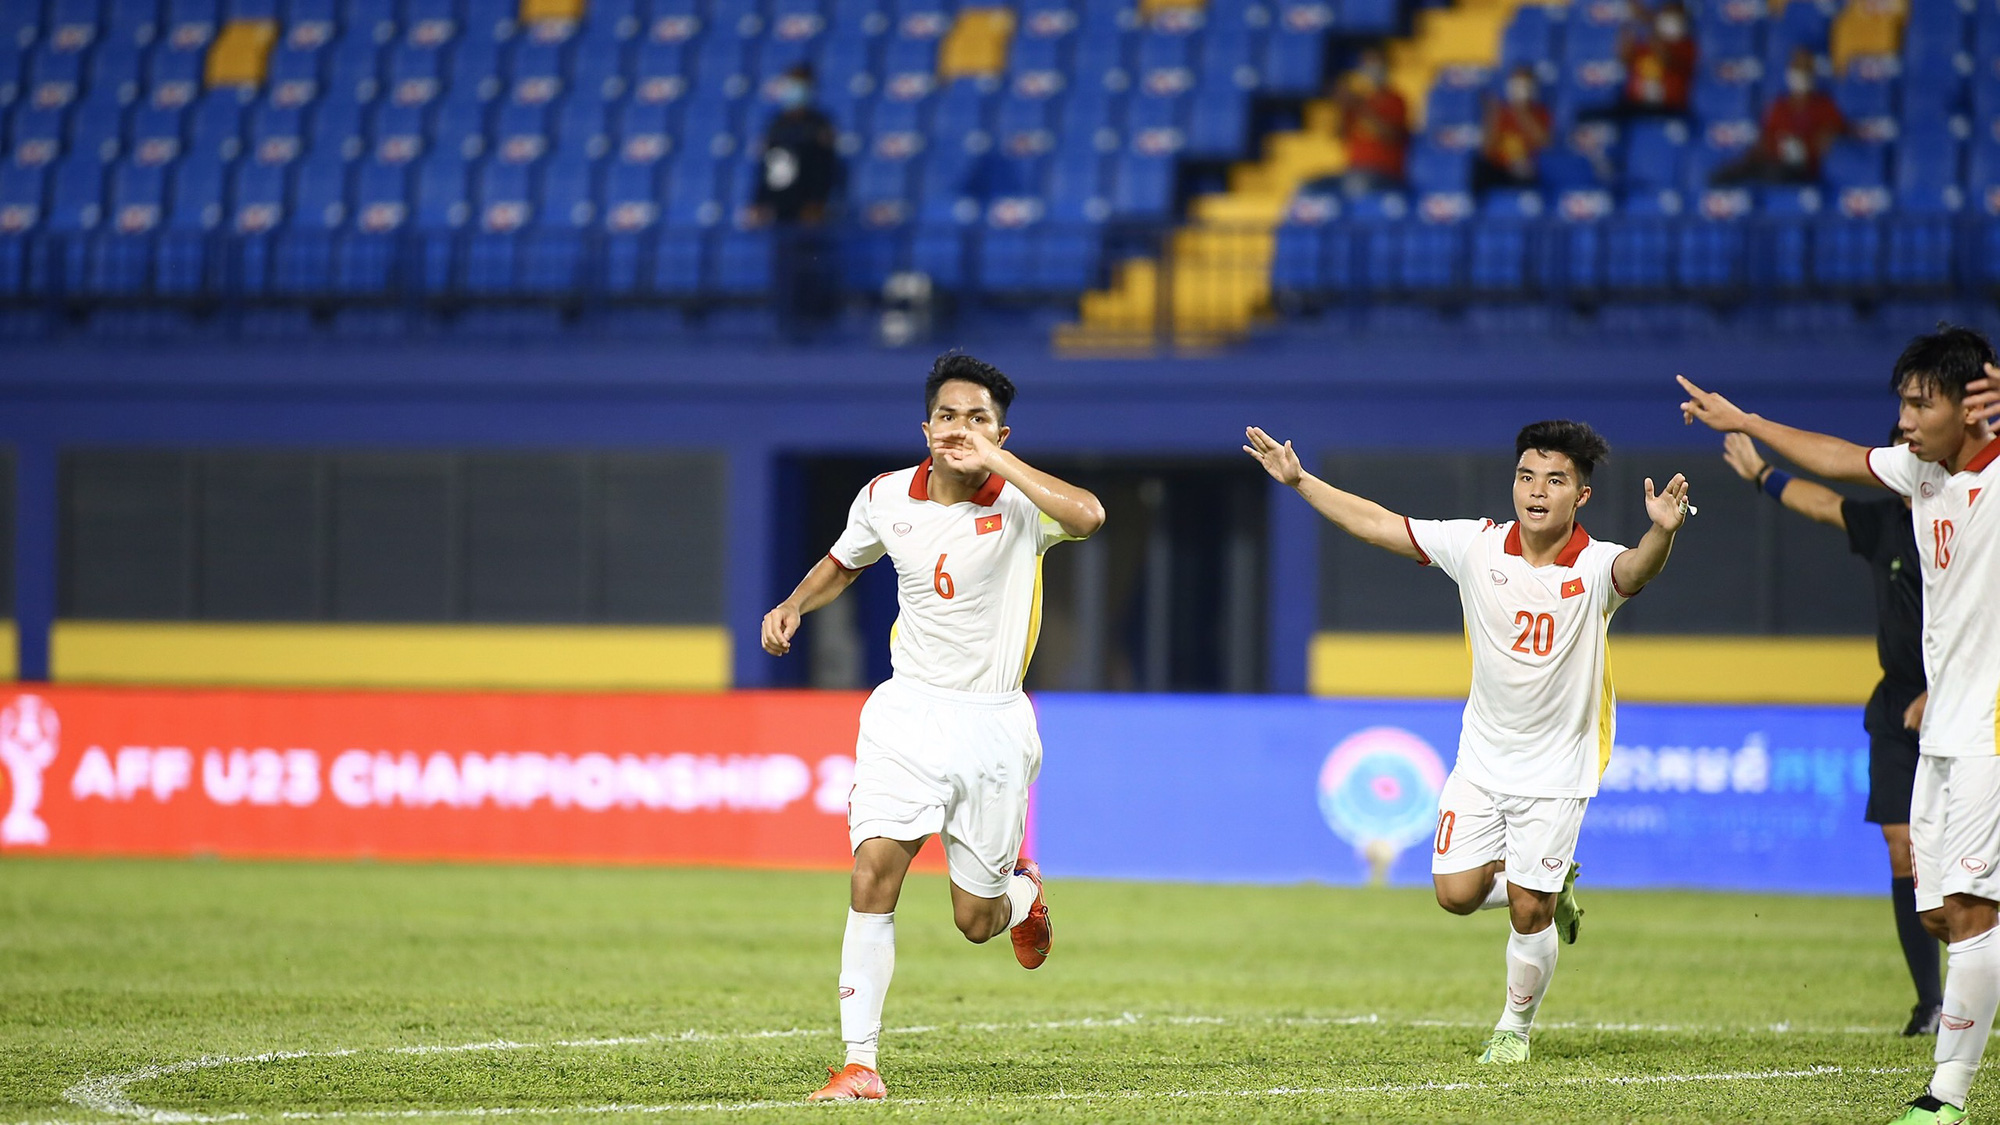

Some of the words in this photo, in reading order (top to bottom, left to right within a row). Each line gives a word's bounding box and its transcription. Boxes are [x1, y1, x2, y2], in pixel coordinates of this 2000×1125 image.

[1933, 519, 1954, 570] 10
[933, 553, 955, 600] 6
[1511, 610, 1555, 657] 20
[71, 746, 193, 803] AFF
[203, 748, 321, 807] U23
[330, 750, 811, 813] CHAMPIONSHIP
[1433, 809, 1456, 855] 0
